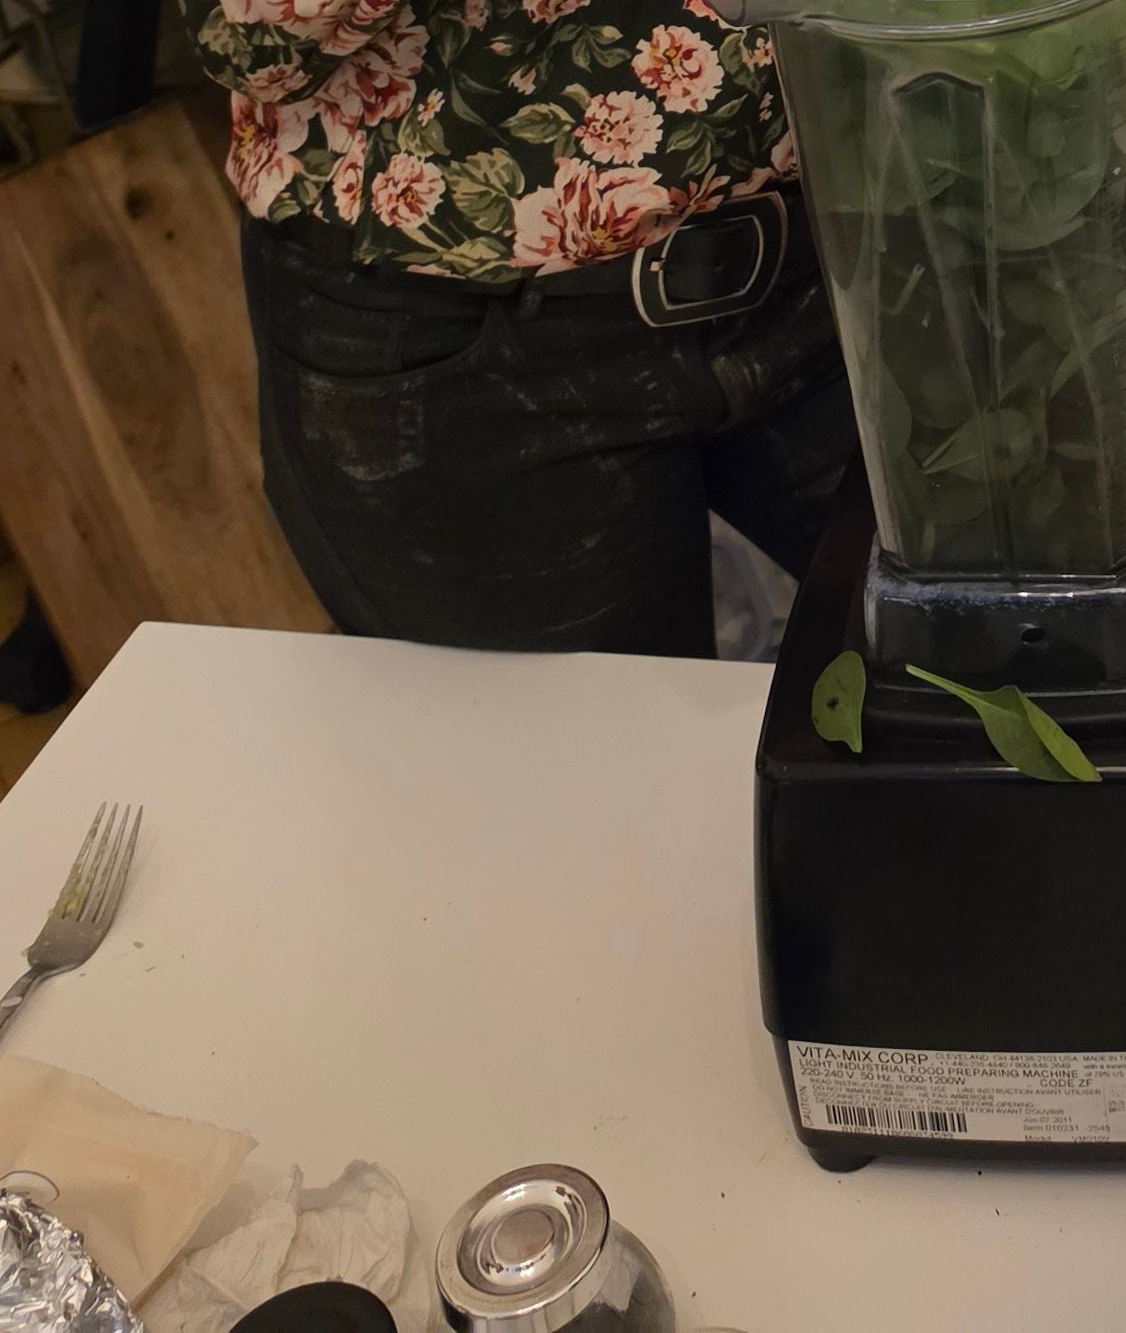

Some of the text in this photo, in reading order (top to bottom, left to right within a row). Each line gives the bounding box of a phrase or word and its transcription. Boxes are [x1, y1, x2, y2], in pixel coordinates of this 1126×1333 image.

[796, 1045, 873, 1063] VITA-MIX
[799, 1059, 1079, 1079] LIGHT INDUSTRIAL FOOD PREPARING MACHINE
[801, 1067, 844, 1079] 220-240
[860, 1072, 875, 1081] 50
[898, 1074, 966, 1086] 1000-1200W
[1039, 1078, 1093, 1088] CODE ZF
